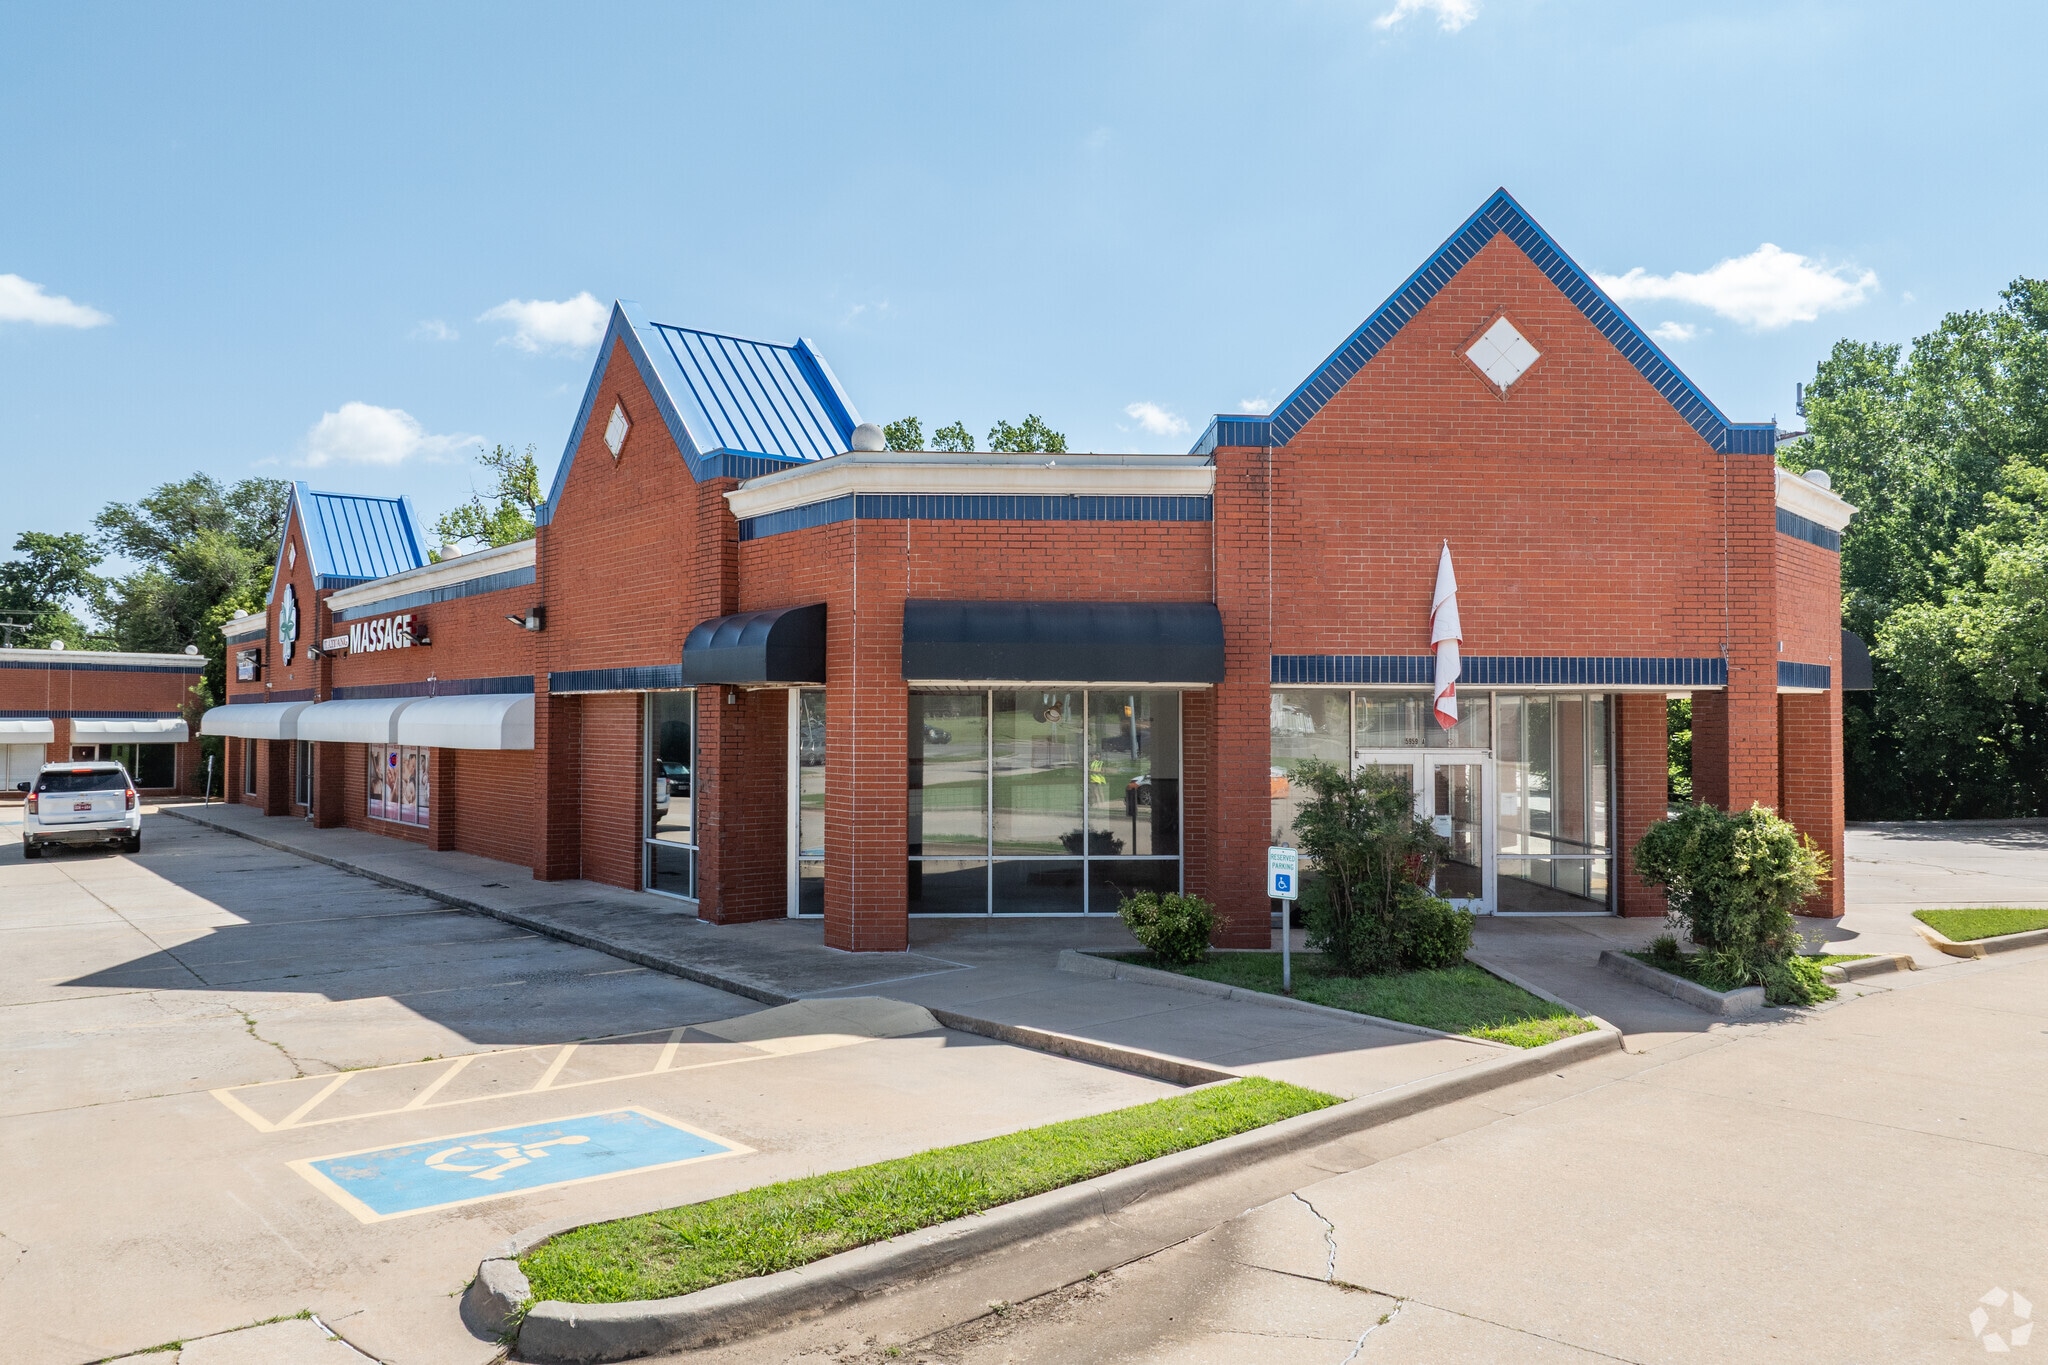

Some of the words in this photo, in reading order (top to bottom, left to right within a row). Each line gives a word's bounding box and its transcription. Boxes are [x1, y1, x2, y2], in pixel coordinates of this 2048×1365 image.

[350, 614, 411, 654] MASSAGE
[1271, 854, 1295, 862] RESERVED
[1272, 862, 1294, 871] PARKING
